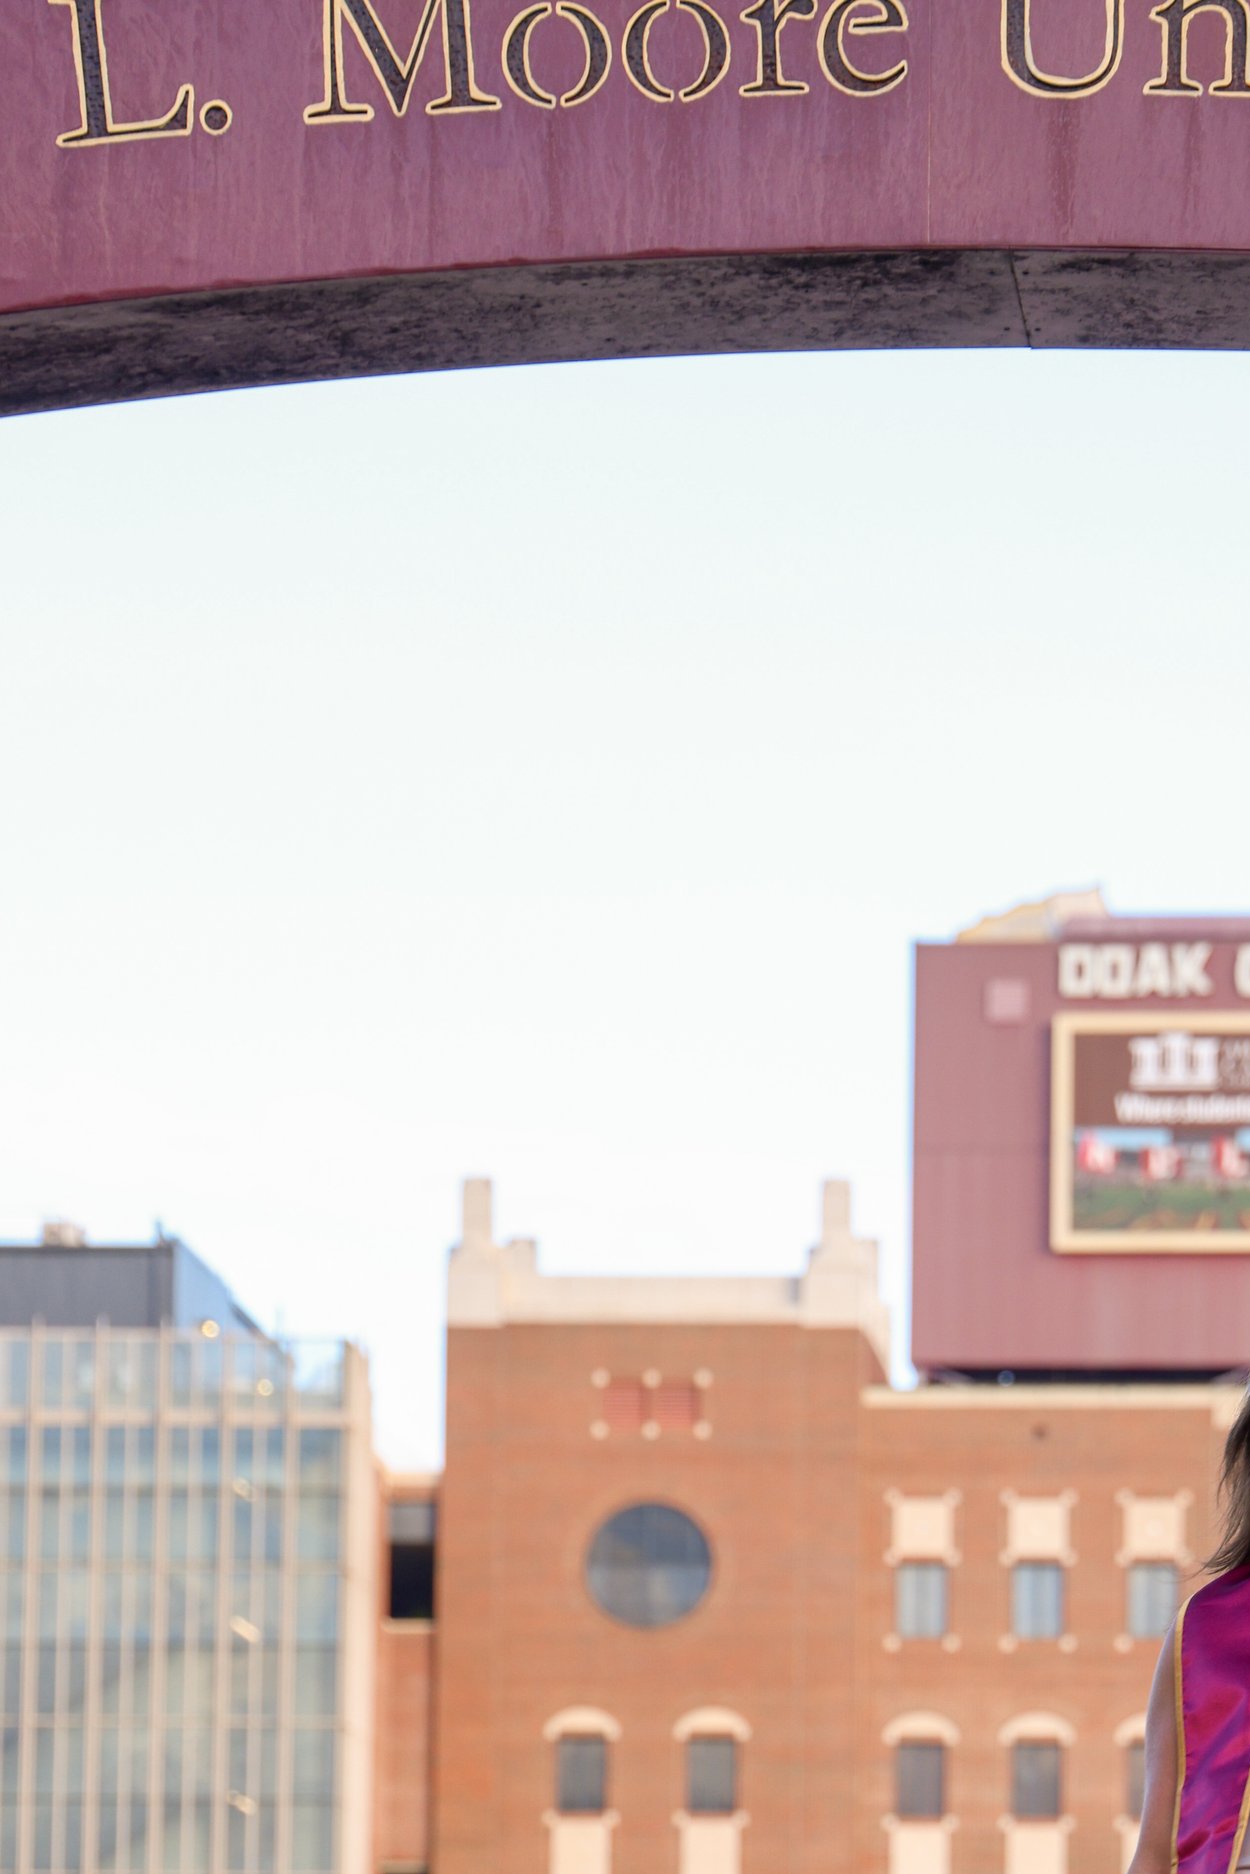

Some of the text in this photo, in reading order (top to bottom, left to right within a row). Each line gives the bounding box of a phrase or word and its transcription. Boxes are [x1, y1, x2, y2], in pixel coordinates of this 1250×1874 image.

[56, 0, 233, 149] L.
[303, 0, 909, 124] Moore
[1058, 940, 1214, 998] DOAK
